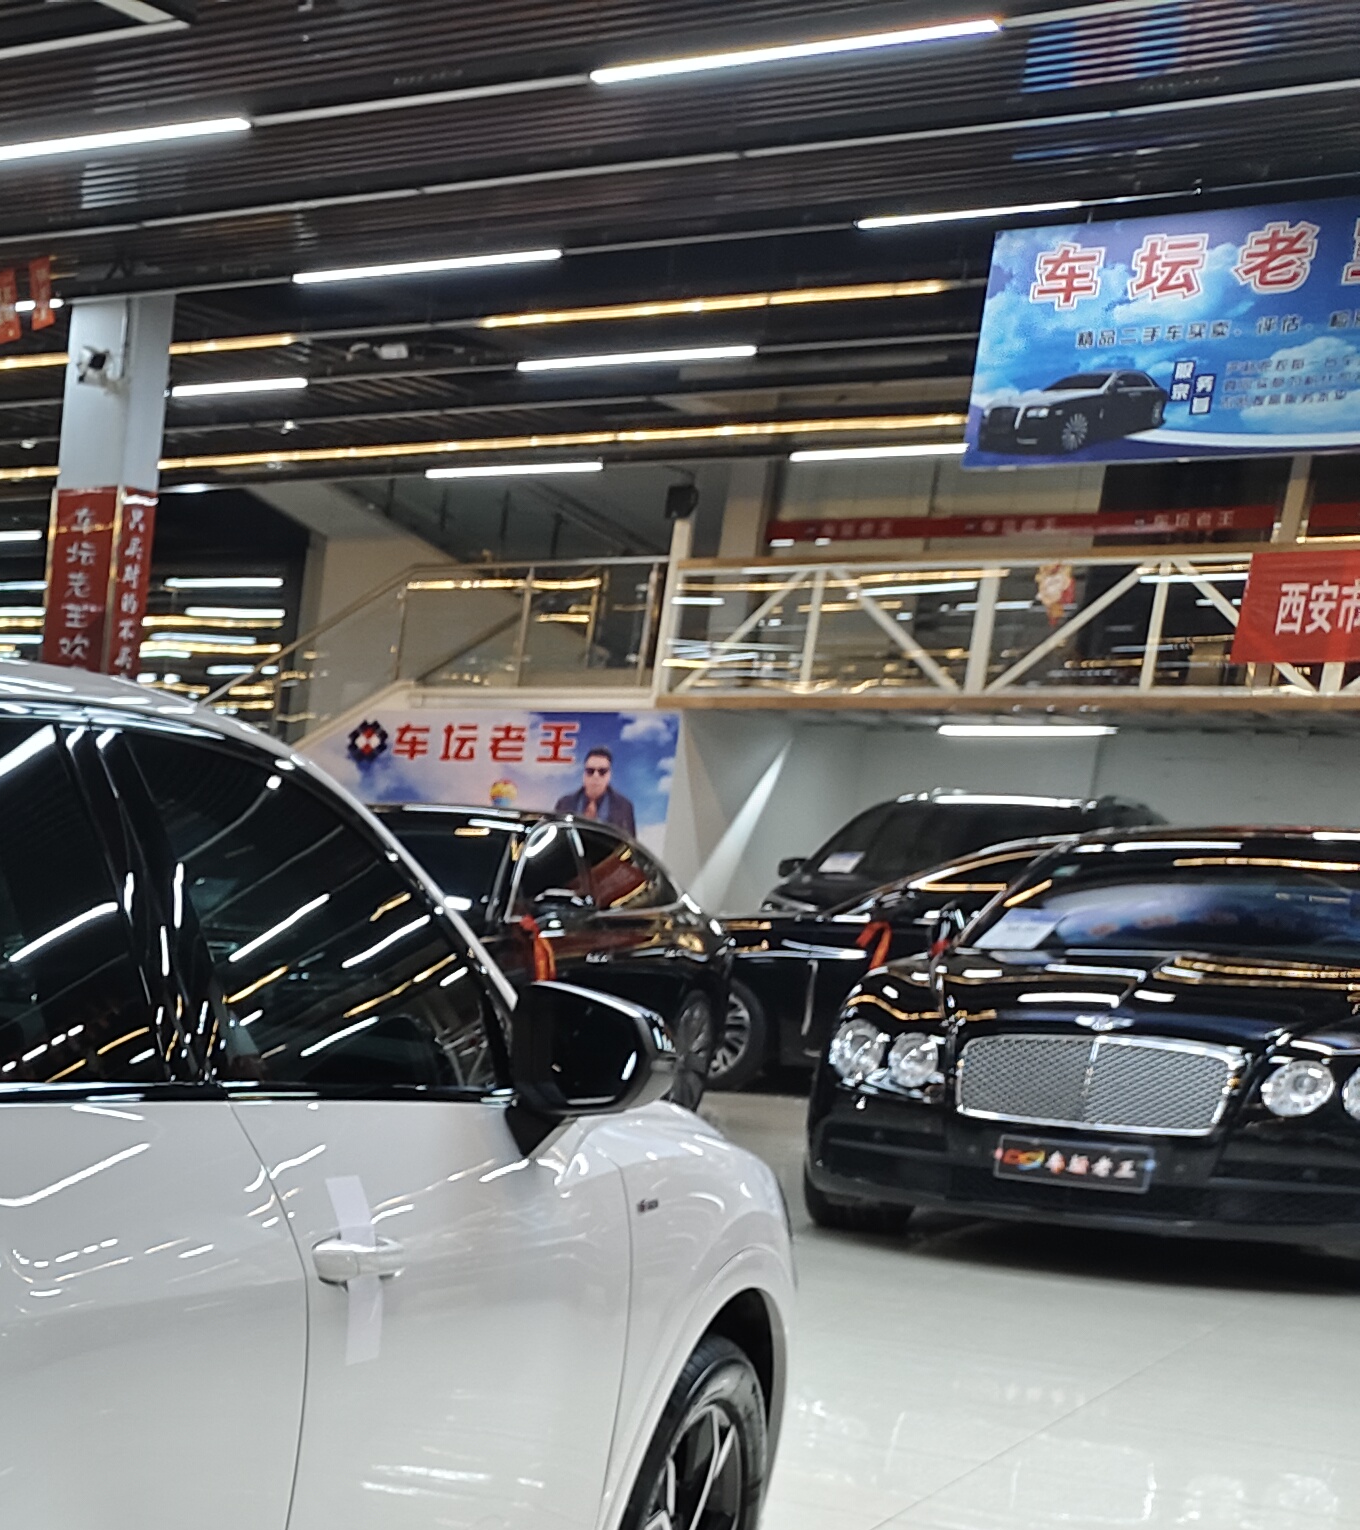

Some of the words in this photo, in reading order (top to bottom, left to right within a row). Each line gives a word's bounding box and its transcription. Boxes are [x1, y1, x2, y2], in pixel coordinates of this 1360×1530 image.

[58, 507, 95, 670] 车坛老王欢
[393, 721, 579, 763] 车坛老王
